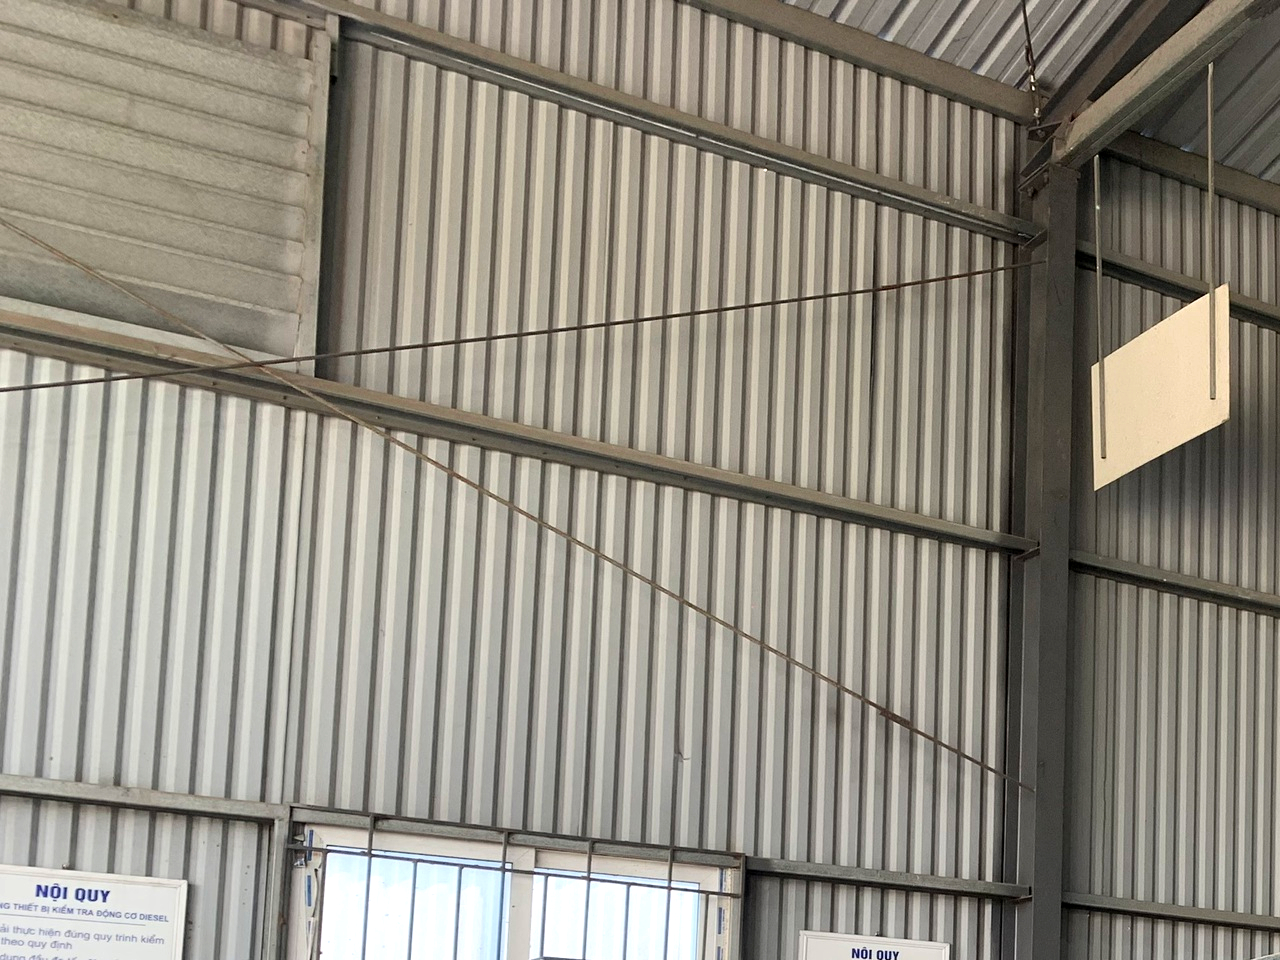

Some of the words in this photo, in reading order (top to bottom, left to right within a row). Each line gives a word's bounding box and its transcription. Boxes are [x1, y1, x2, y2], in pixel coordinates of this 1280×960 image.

[36, 883, 68, 901] NỘI
[75, 888, 110, 903] QUY
[14, 902, 38, 911] THIẾT
[41, 906, 50, 914] BỊ
[53, 905, 74, 914] KIỂM
[96, 909, 121, 918] ĐỘNG
[139, 914, 168, 922] DIESEL
[1, 938, 24, 946] theo
[27, 940, 46, 949] quy
[50, 940, 72, 950] định
[852, 947, 872, 960] NỘI
